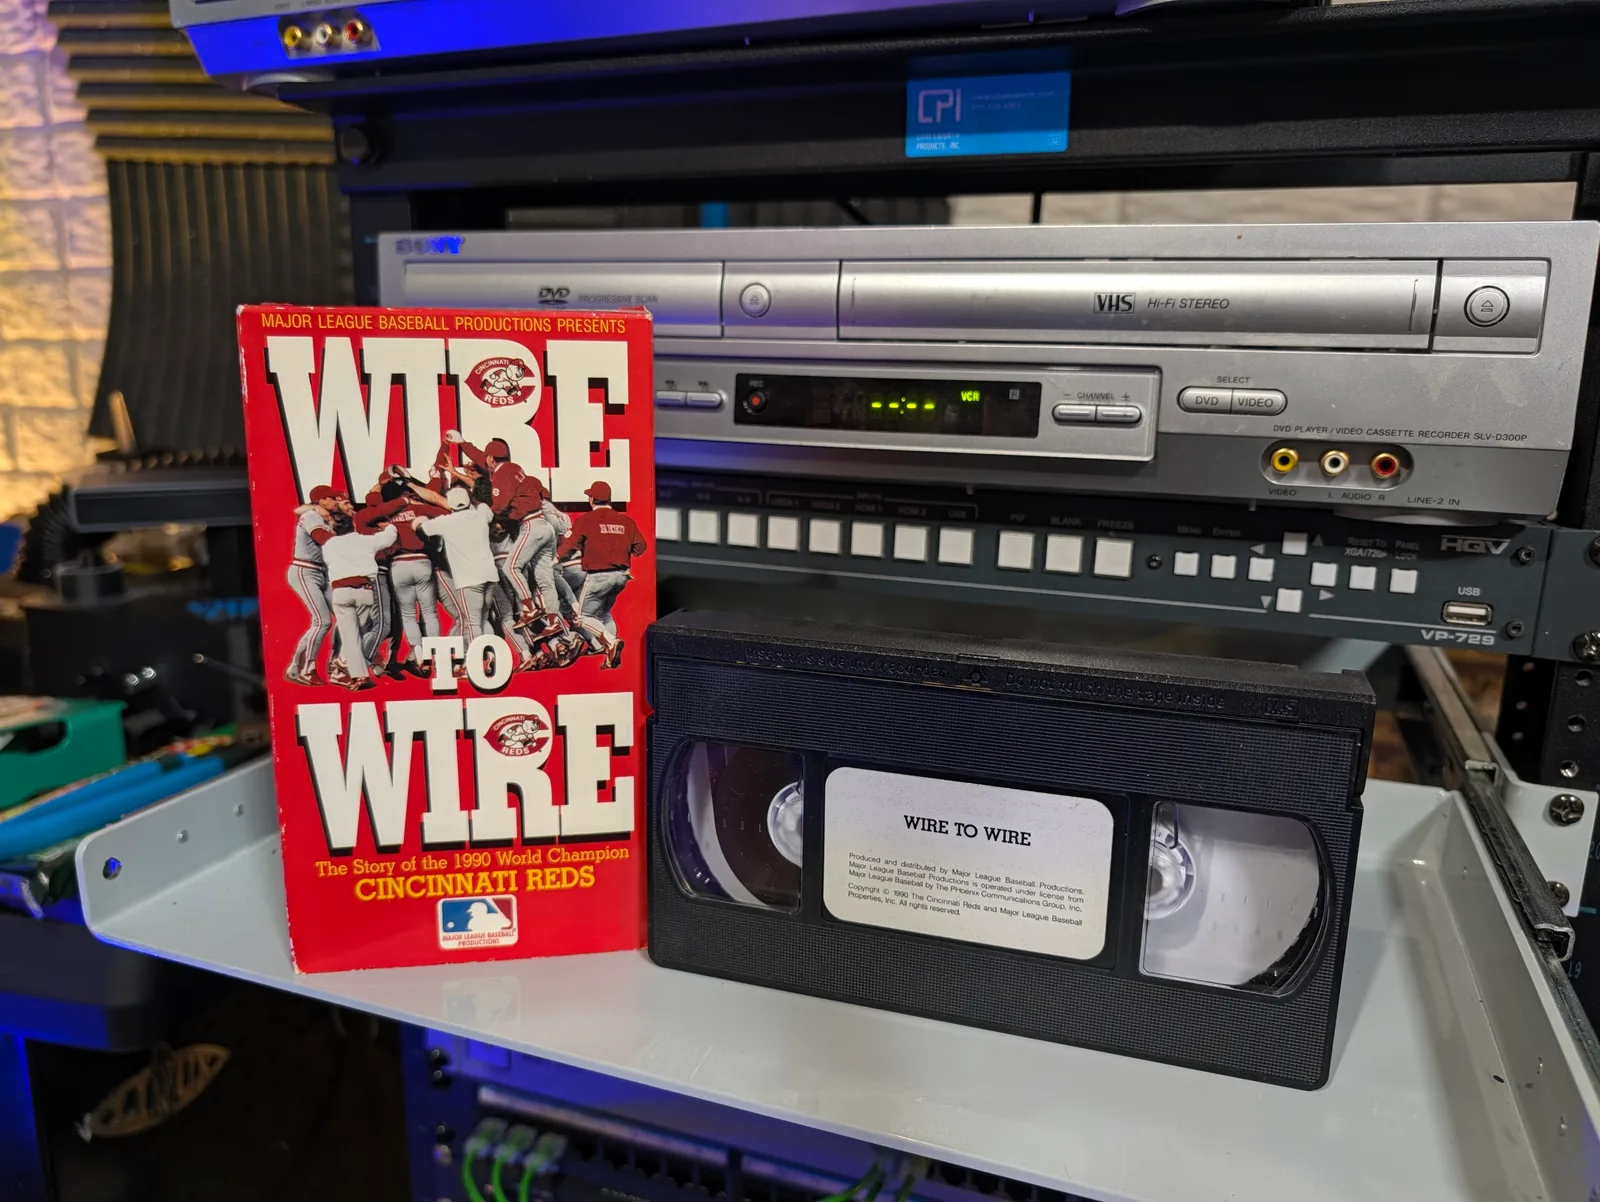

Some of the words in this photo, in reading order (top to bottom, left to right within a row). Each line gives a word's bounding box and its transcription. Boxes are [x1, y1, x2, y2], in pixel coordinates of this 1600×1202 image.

[917, 88, 962, 124] CPI
[538, 287, 570, 303] DVD
[1095, 293, 1133, 312] VHS
[1178, 297, 1230, 311] STEREO
[261, 313, 312, 329] MAJOR
[318, 314, 373, 330] LEAGUE
[378, 316, 450, 332] BASEBALL
[455, 317, 552, 333] PRODUCTIONS
[557, 318, 626, 334] PRESENTS
[475, 359, 509, 375] CINCINNATI
[1216, 374, 1250, 385] SELECT
[484, 394, 515, 405] REDS
[960, 390, 981, 402] VCR
[1076, 392, 1115, 401] CHANNEL
[1194, 395, 1219, 406] DVD
[1236, 396, 1274, 408] VIDEO
[265, 335, 632, 505] WIRE
[1273, 424, 1292, 433] DVD
[1335, 427, 1364, 436] VIDEO
[1366, 428, 1415, 438] CASSETTE
[1417, 430, 1470, 440] RECORDER
[1473, 432, 1528, 442] SLV-D300P
[1268, 488, 1297, 497] VIDEO
[1340, 492, 1372, 502] AUDIO
[1407, 496, 1445, 506] LINE-2
[1448, 498, 1460, 507] IN
[1050, 515, 1082, 527] BLANK
[1097, 518, 1135, 530] FREEZE
[1440, 536, 1511, 555] HQV
[1457, 586, 1481, 597] USB
[1420, 629, 1496, 646] VP-729
[421, 633, 514, 690] TO
[493, 715, 525, 731] CINCINNATI
[501, 746, 530, 756] REDS
[297, 691, 635, 850] WIRE
[903, 815, 949, 835] WIRE
[954, 821, 978, 838] TO
[983, 826, 1032, 847] WIRE
[316, 861, 348, 877] The
[352, 858, 395, 878] Story
[400, 857, 417, 873] of
[421, 856, 448, 870] the
[454, 852, 492, 869] 1990
[495, 849, 542, 866] World
[547, 846, 630, 867] Champion
[848, 852, 881, 864] Produced
[884, 859, 898, 867] and
[900, 860, 936, 873] distributed
[940, 866, 948, 875] by
[952, 868, 971, 878] Major
[974, 871, 1002, 883] League
[1039, 881, 1084, 895] Productions.
[354, 871, 518, 902] CINCINNATI
[526, 866, 596, 891] REDS
[848, 861, 867, 870] Major
[869, 864, 895, 875] League
[897, 868, 926, 879] Baseball
[928, 873, 970, 886] Productions
[980, 882, 1013, 893] operated
[1015, 888, 1037, 897] under
[1039, 890, 1065, 901] license
[1067, 895, 1084, 904] from
[848, 869, 867, 879] Major
[868, 872, 894, 884] League
[894, 876, 924, 888] Baseball
[925, 882, 934, 891] by
[935, 883, 949, 892] The
[980, 890, 1041, 907] Communications
[1041, 900, 1067, 911] Group,
[847, 889, 883, 904] Properties,
[898, 899, 908, 907] All
[908, 901, 928, 911] rights
[929, 905, 961, 917] reserved.
[847, 881, 880, 894] Copyright
[893, 890, 909, 899] 1990
[911, 892, 925, 902] The
[926, 895, 961, 907] Cincinnati
[962, 901, 981, 911] Reds
[983, 904, 998, 913] and
[999, 907, 1019, 918] Major
[1021, 910, 1050, 922] League
[1051, 914, 1083, 927] Baseball
[458, 938, 500, 946] PRODUCTIONS
[464, 932, 486, 940] LEAGUE
